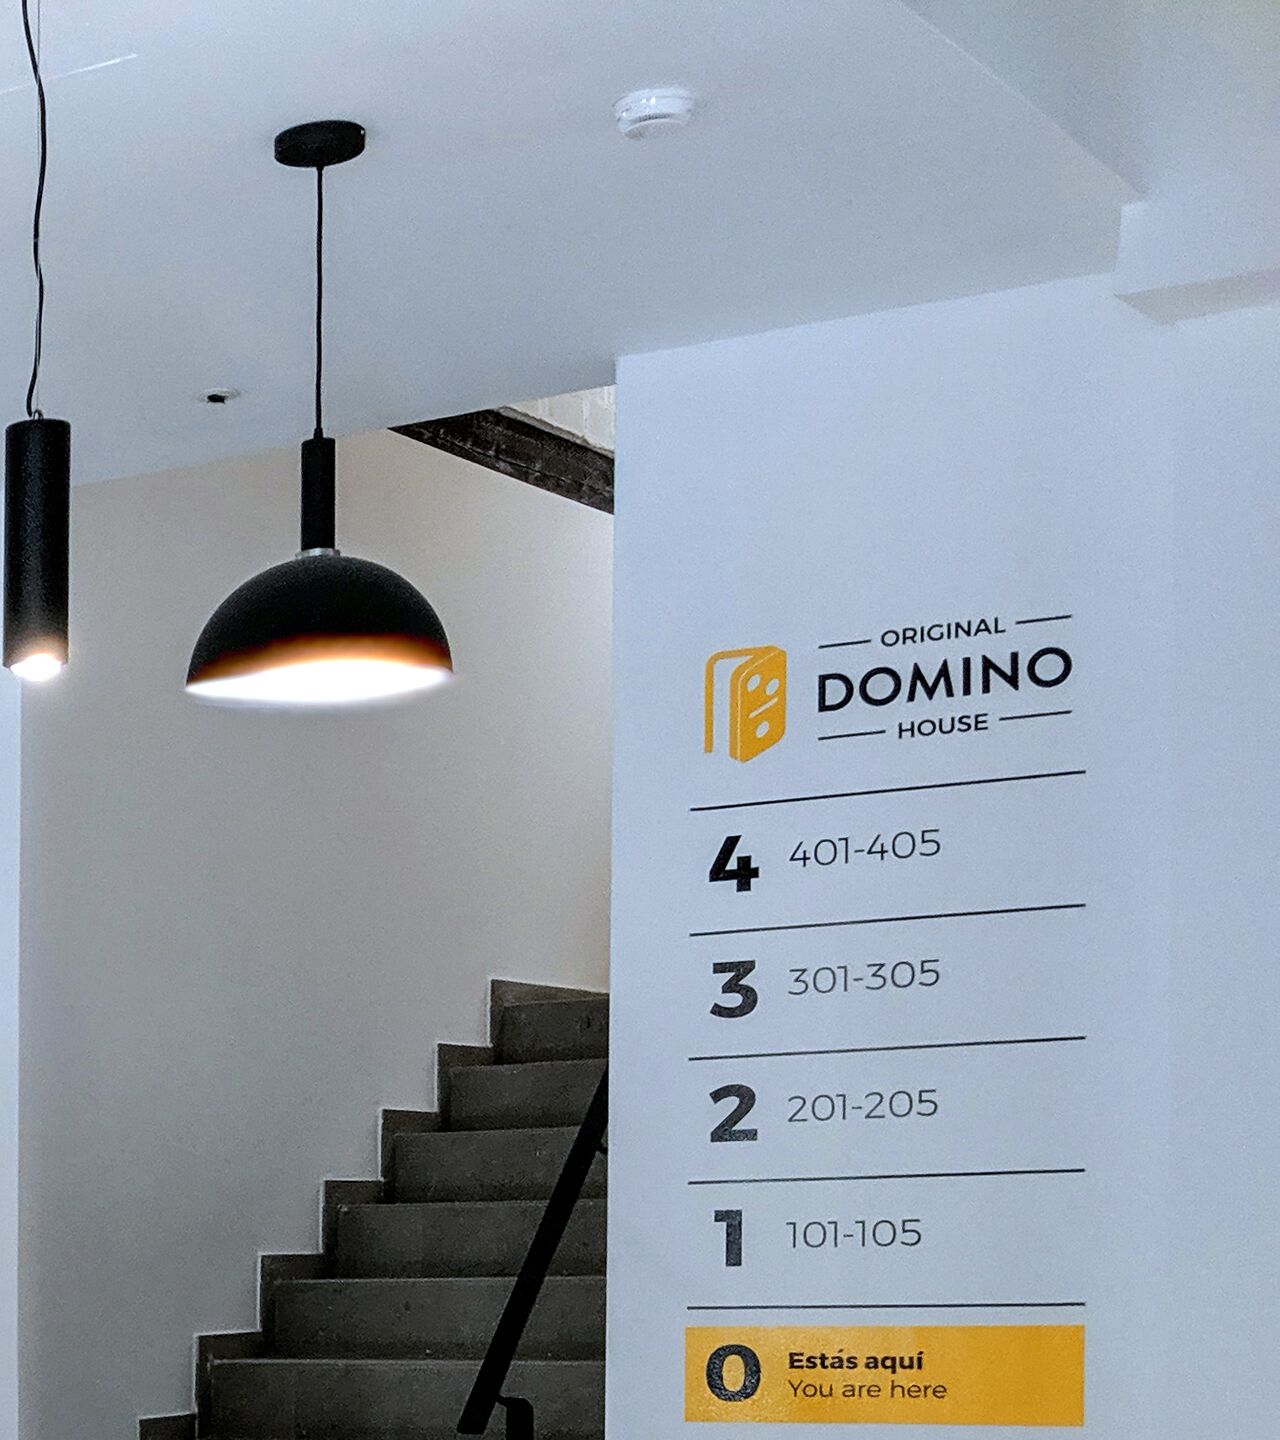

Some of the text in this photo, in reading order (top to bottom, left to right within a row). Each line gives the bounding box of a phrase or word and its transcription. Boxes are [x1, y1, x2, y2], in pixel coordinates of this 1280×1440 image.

[881, 617, 1006, 647] ORIGINAL
[817, 647, 1073, 713] DOMINO
[899, 713, 988, 739] HOUSE
[709, 829, 940, 892] 4 401-405
[710, 959, 939, 1018] 3 301-305
[710, 1084, 938, 1142] 2 201-205
[714, 1210, 921, 1266] 1 101-105
[788, 1380, 947, 1399] You are here
[789, 1349, 923, 1374] Estás aquí
